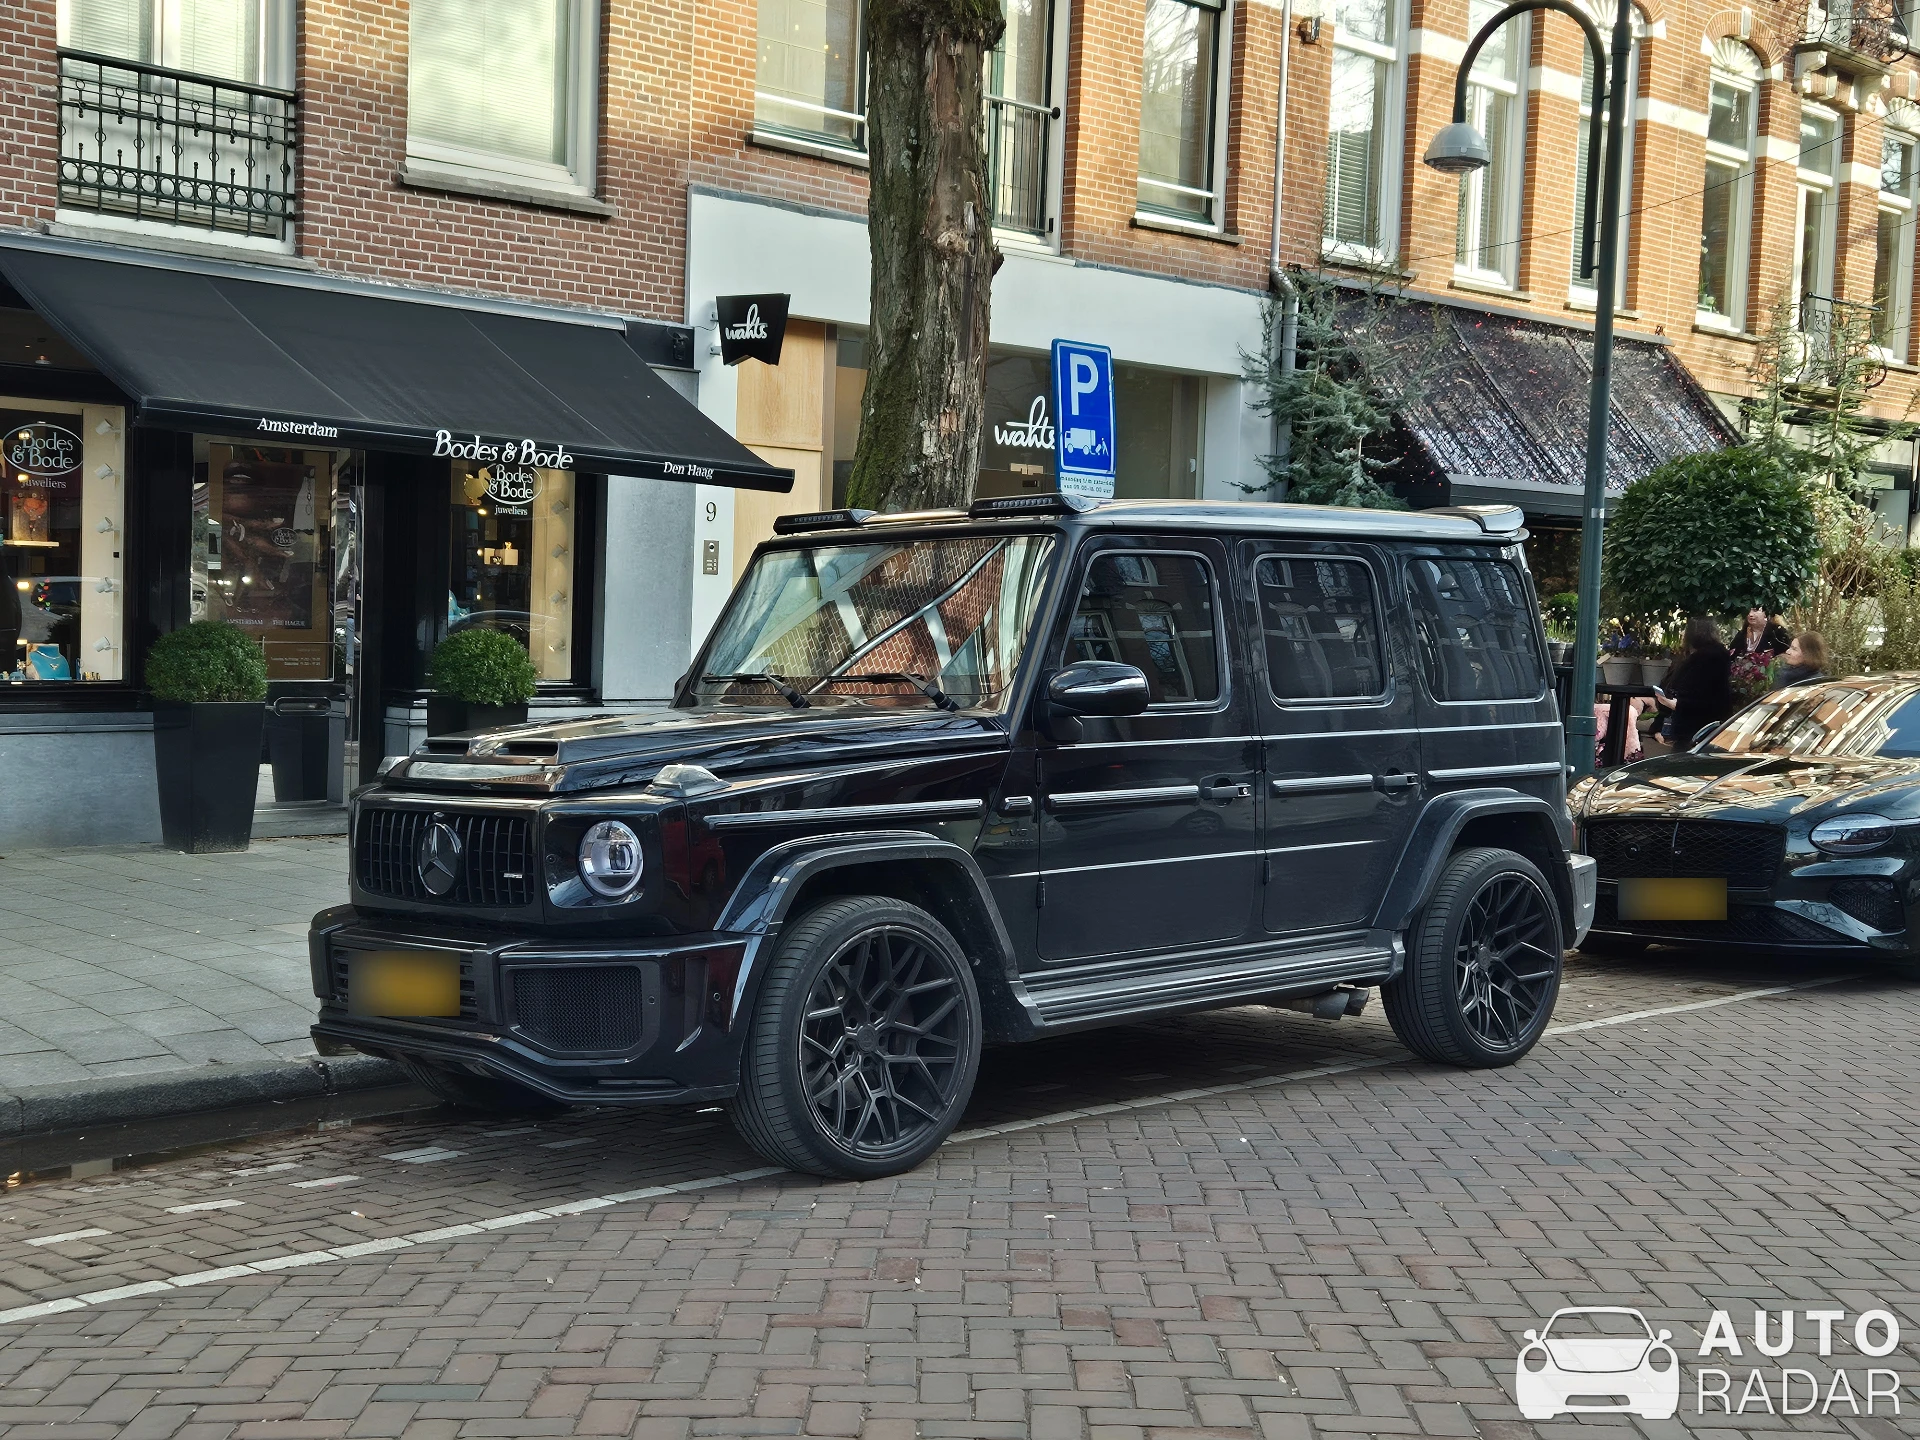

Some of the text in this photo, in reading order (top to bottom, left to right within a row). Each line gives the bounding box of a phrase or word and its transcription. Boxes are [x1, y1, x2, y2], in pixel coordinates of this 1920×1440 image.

[1070, 353, 1099, 416] P
[256, 417, 338, 438] Amsterdam
[21, 428, 74, 451] Bodes
[432, 429, 574, 470] Bodes & Bode
[11, 444, 74, 469] & Bode
[495, 463, 534, 484] Bodes
[663, 461, 715, 480] Den Haag
[488, 478, 534, 499] & Bode
[494, 504, 528, 516] juweliers
[706, 501, 717, 522] 9
